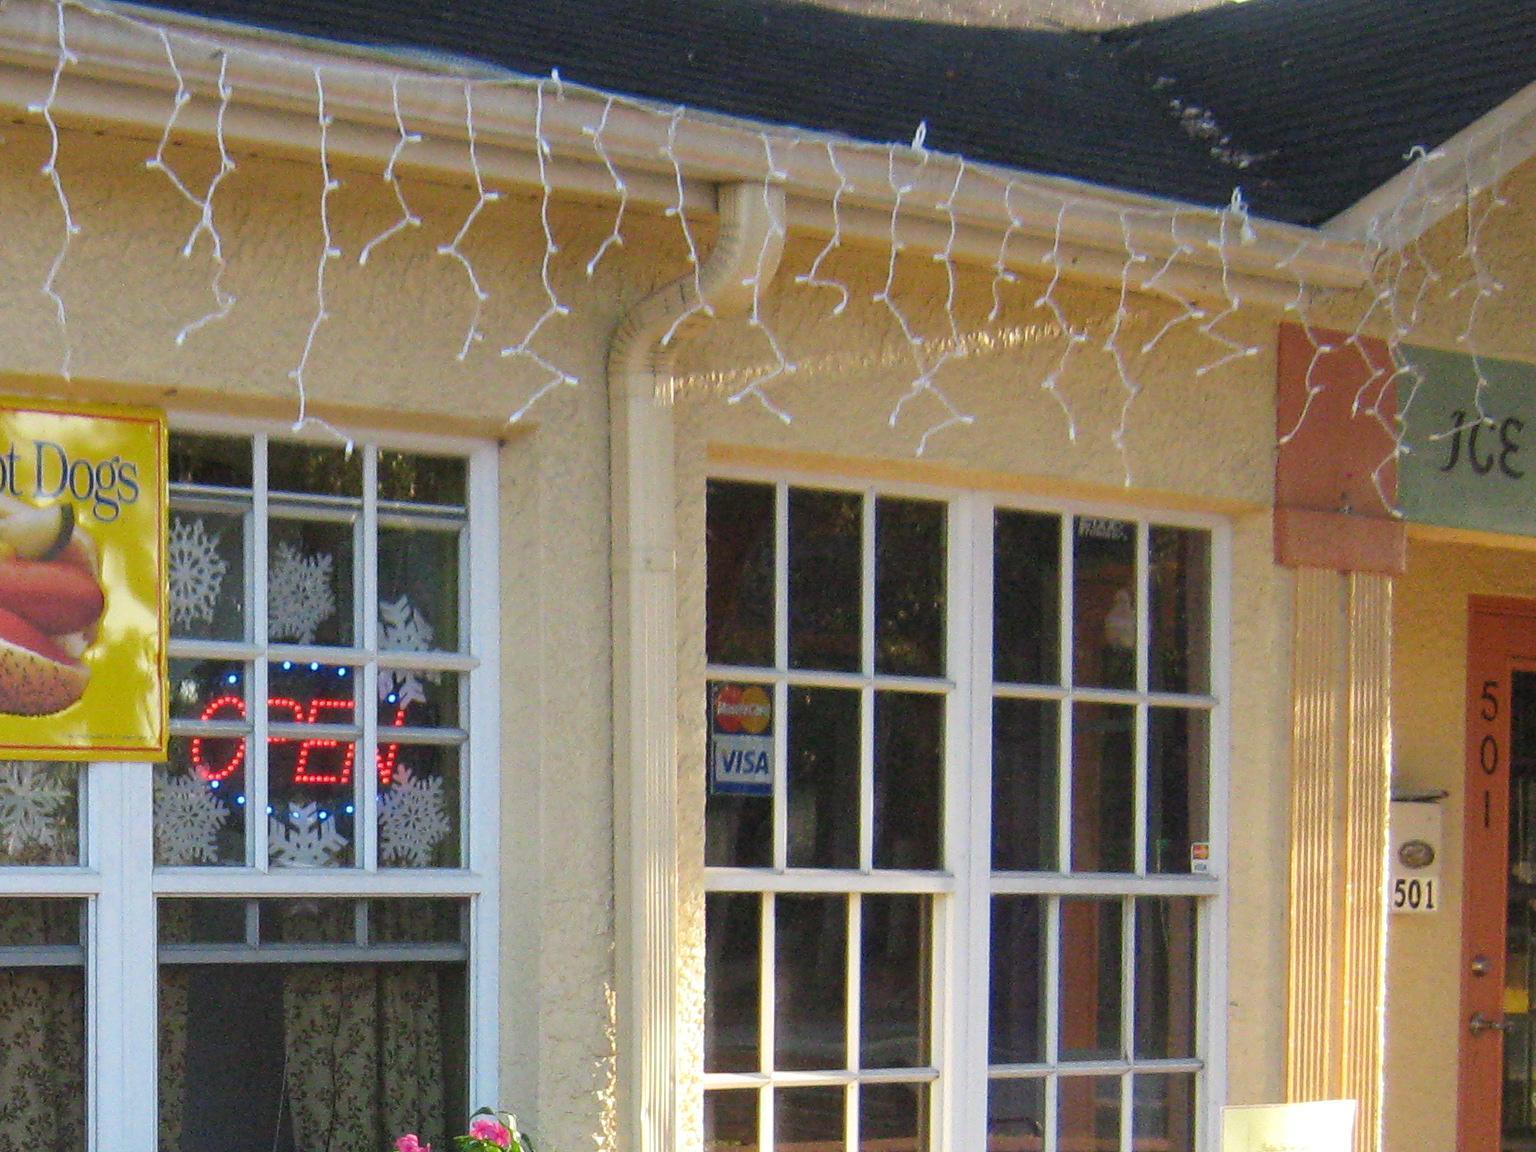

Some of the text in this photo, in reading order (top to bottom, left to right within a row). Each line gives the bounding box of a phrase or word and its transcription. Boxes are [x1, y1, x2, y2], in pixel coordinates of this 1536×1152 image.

[33, 440, 140, 521] Dogs
[723, 750, 769, 775] VISA
[1394, 878, 1434, 909] 501
